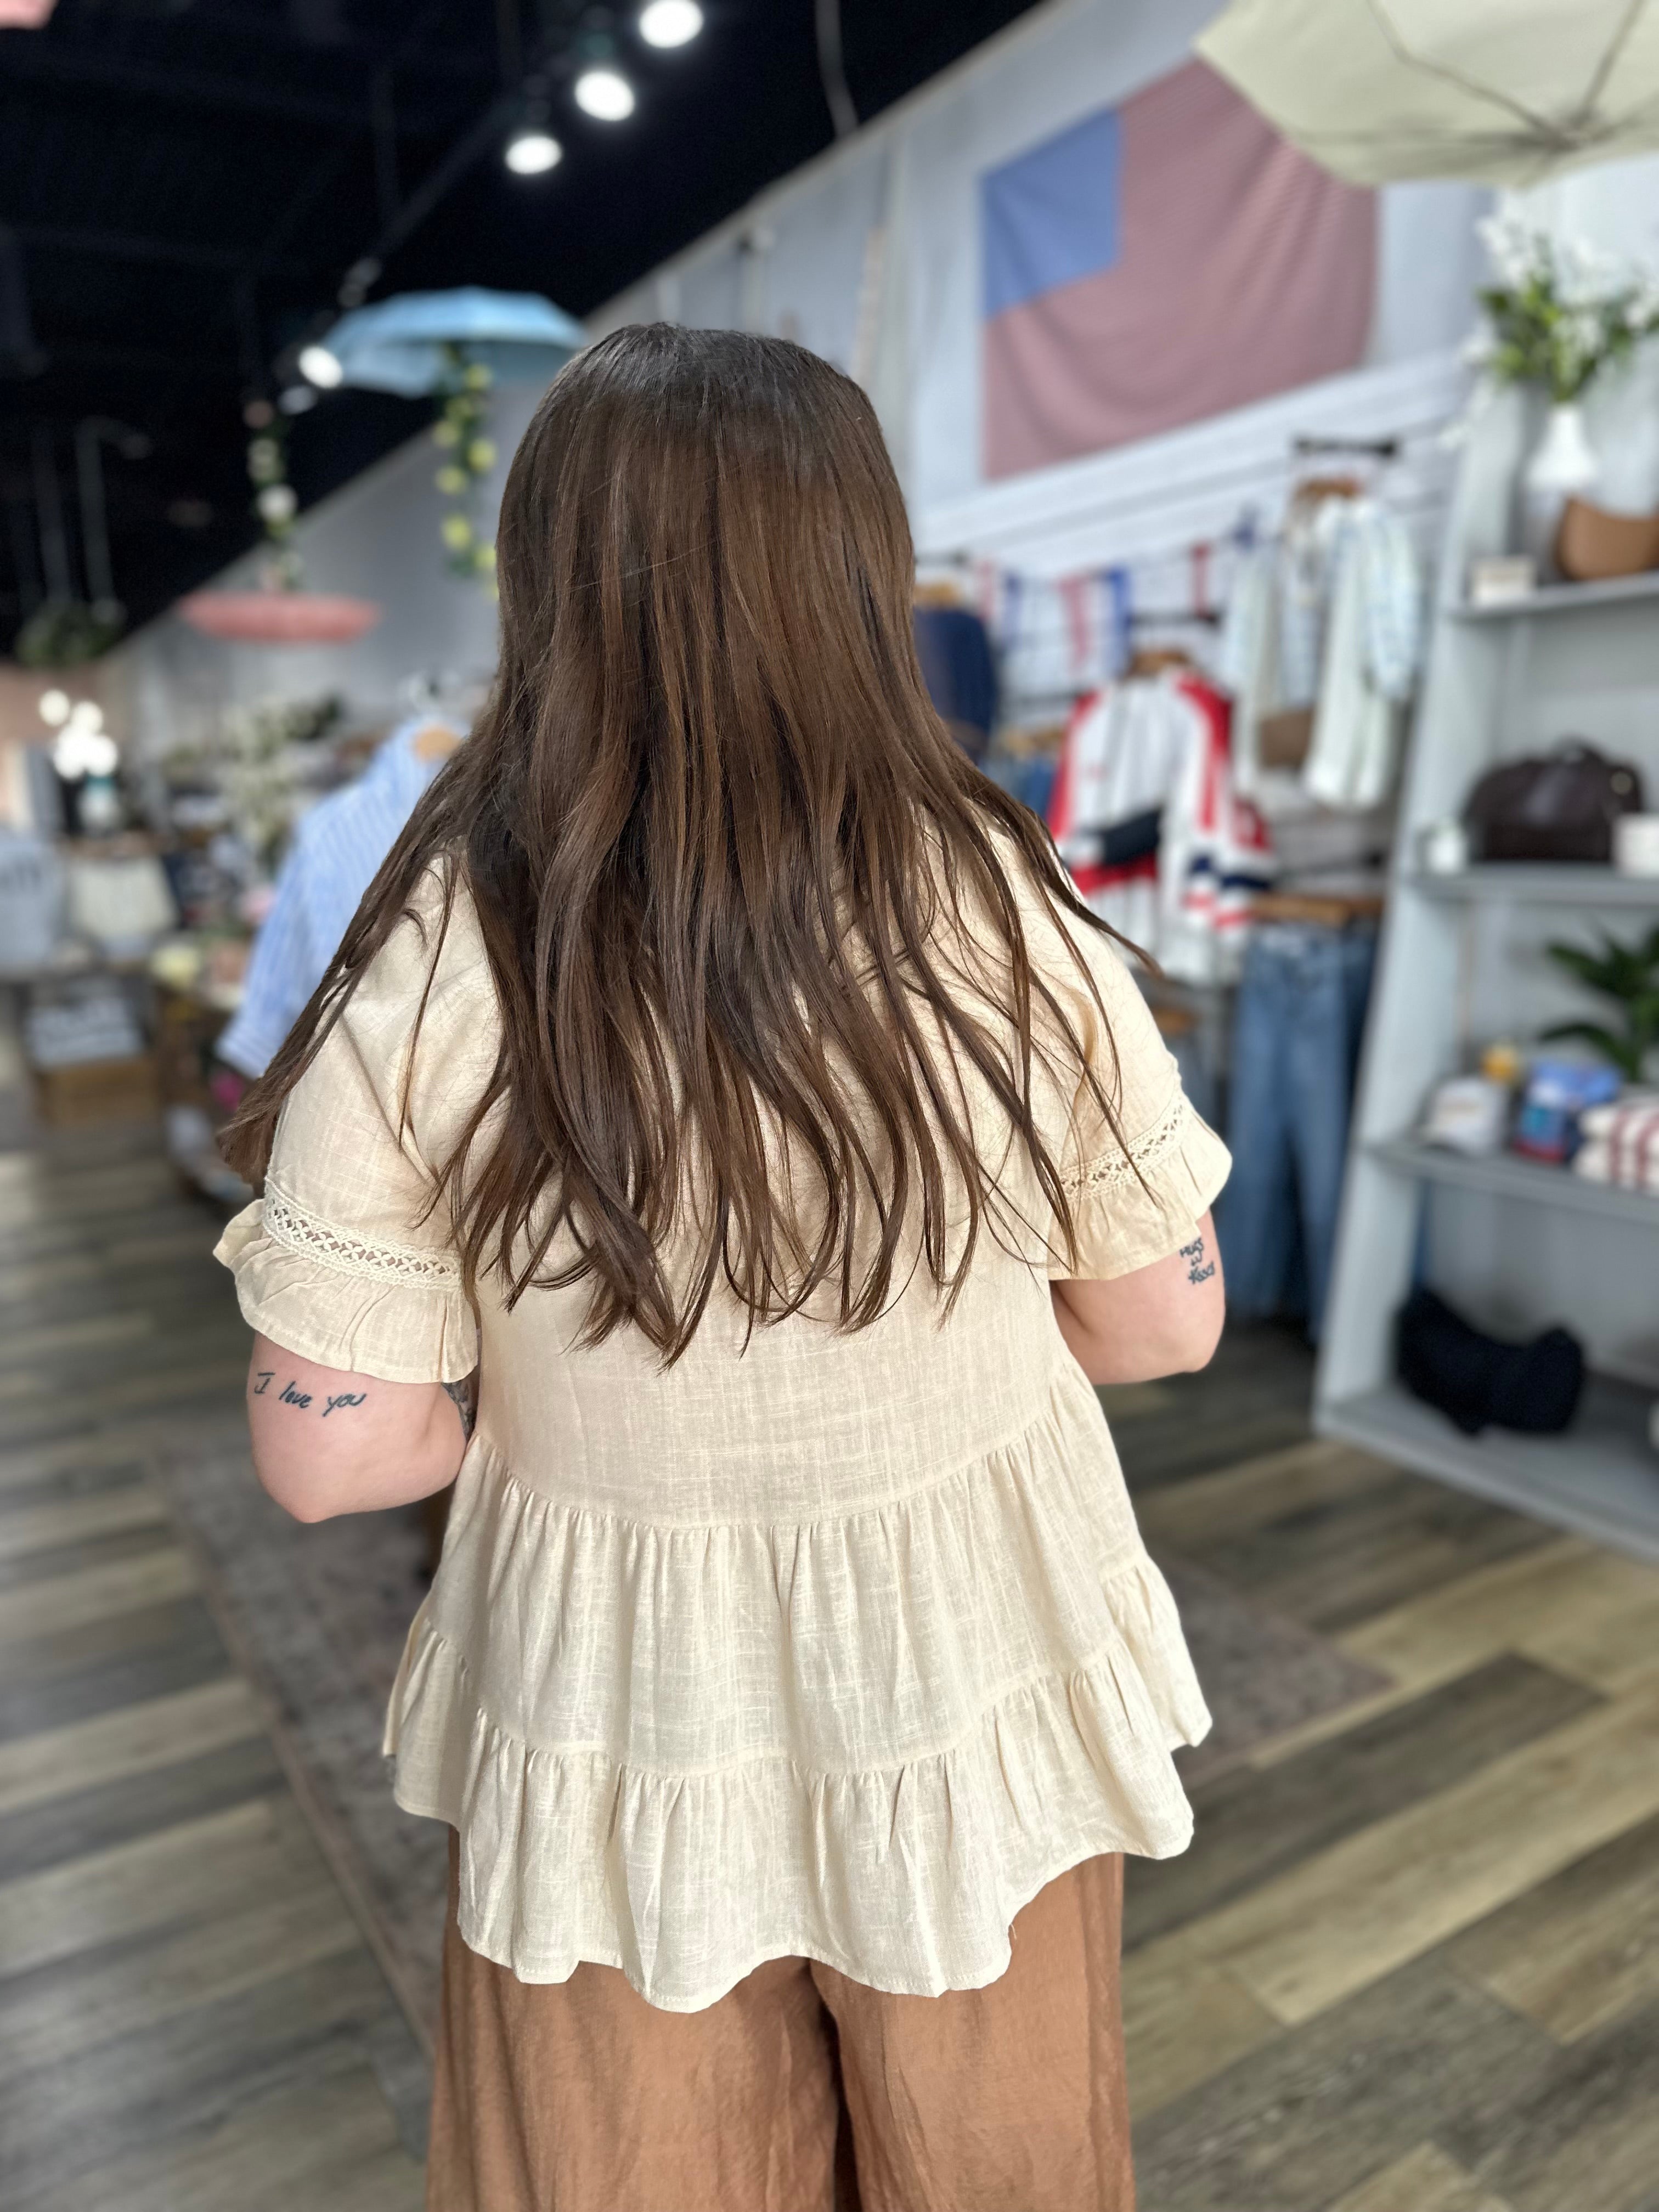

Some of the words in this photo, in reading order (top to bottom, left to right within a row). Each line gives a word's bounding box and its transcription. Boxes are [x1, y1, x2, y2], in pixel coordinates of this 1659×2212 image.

[254, 1372, 275, 1394] I
[279, 1380, 313, 1409] love
[322, 1393, 368, 1417] you
